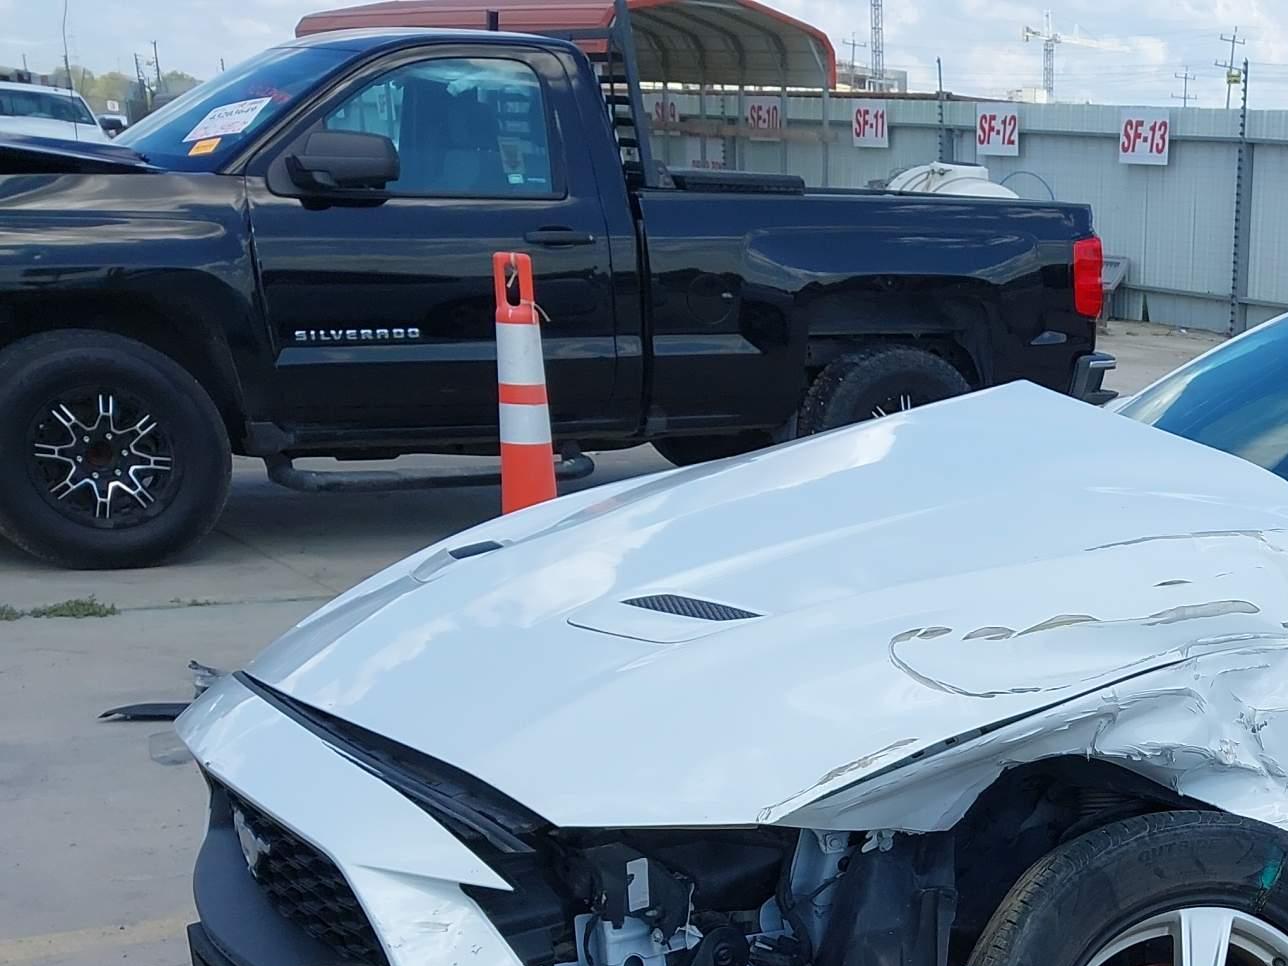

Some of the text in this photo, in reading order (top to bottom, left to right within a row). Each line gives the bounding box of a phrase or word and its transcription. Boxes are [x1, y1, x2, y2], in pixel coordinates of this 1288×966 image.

[750, 104, 778, 129] SF-10
[854, 108, 886, 138] SF-11
[978, 114, 1017, 145] SF-12
[1121, 119, 1168, 154] SF-13
[294, 327, 420, 341] SILVERADO
